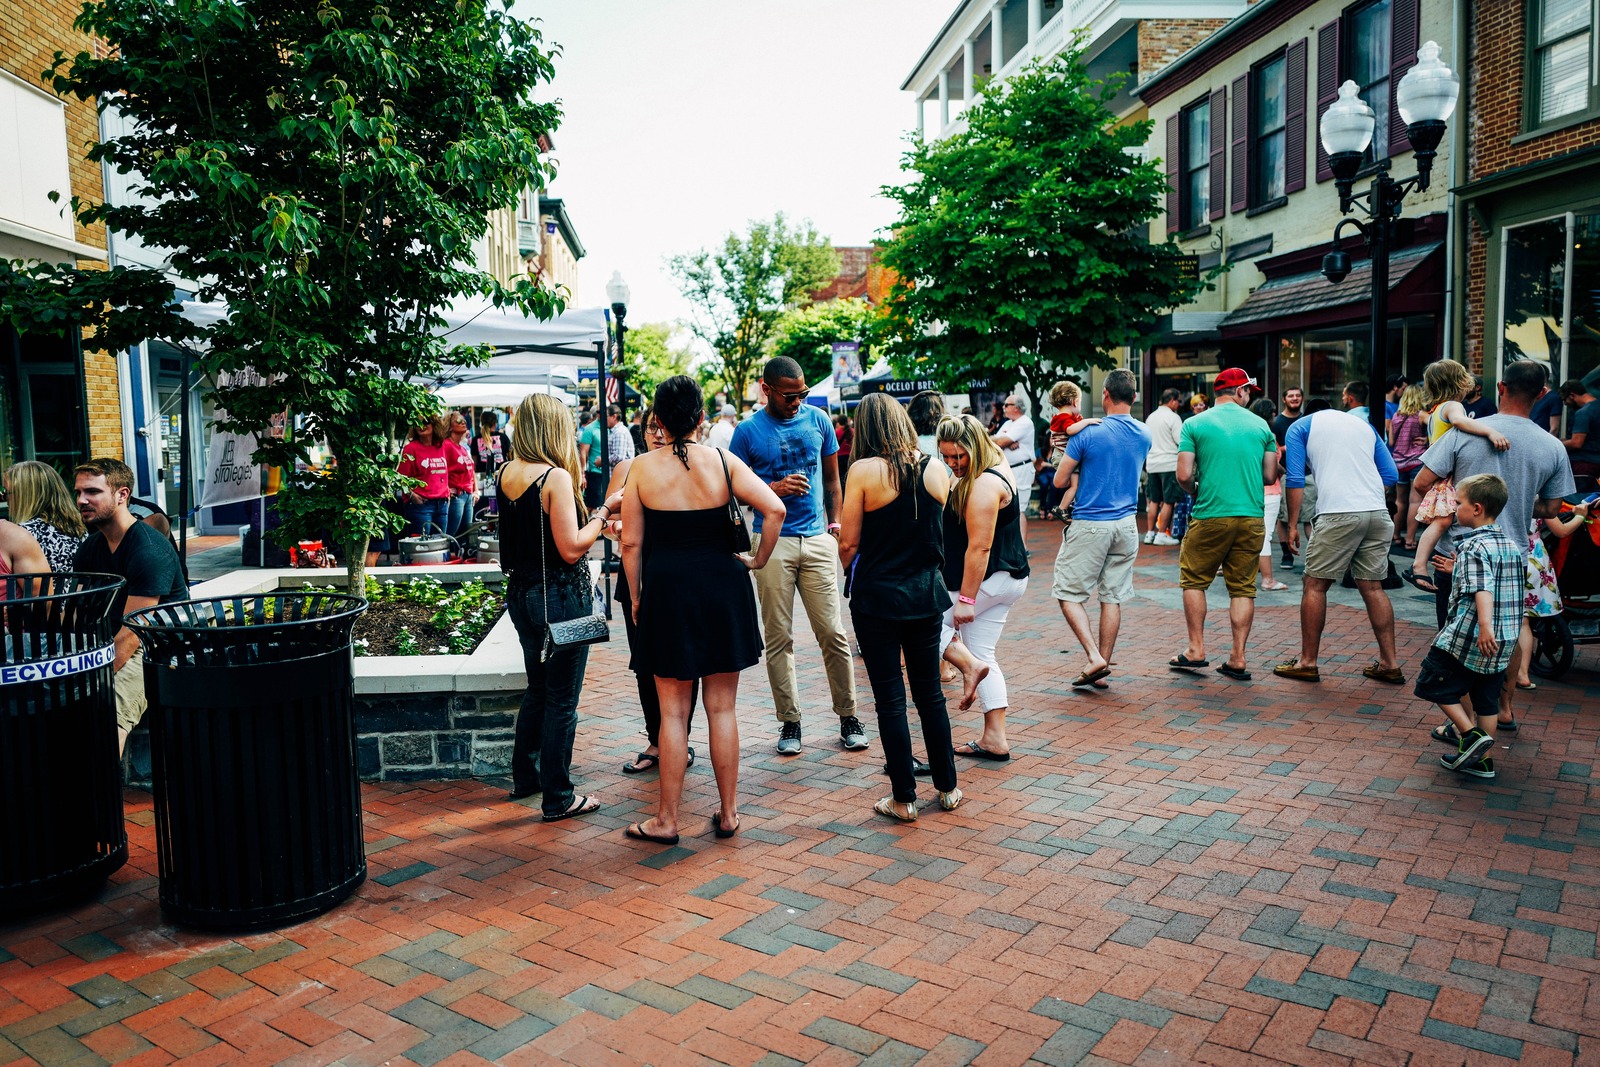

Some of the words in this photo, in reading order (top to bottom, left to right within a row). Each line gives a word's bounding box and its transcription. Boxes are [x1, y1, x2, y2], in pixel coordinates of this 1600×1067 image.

[885, 382, 915, 392] OCELOT
[213, 461, 253, 486] strategies
[0, 651, 104, 684] ECYCLING
